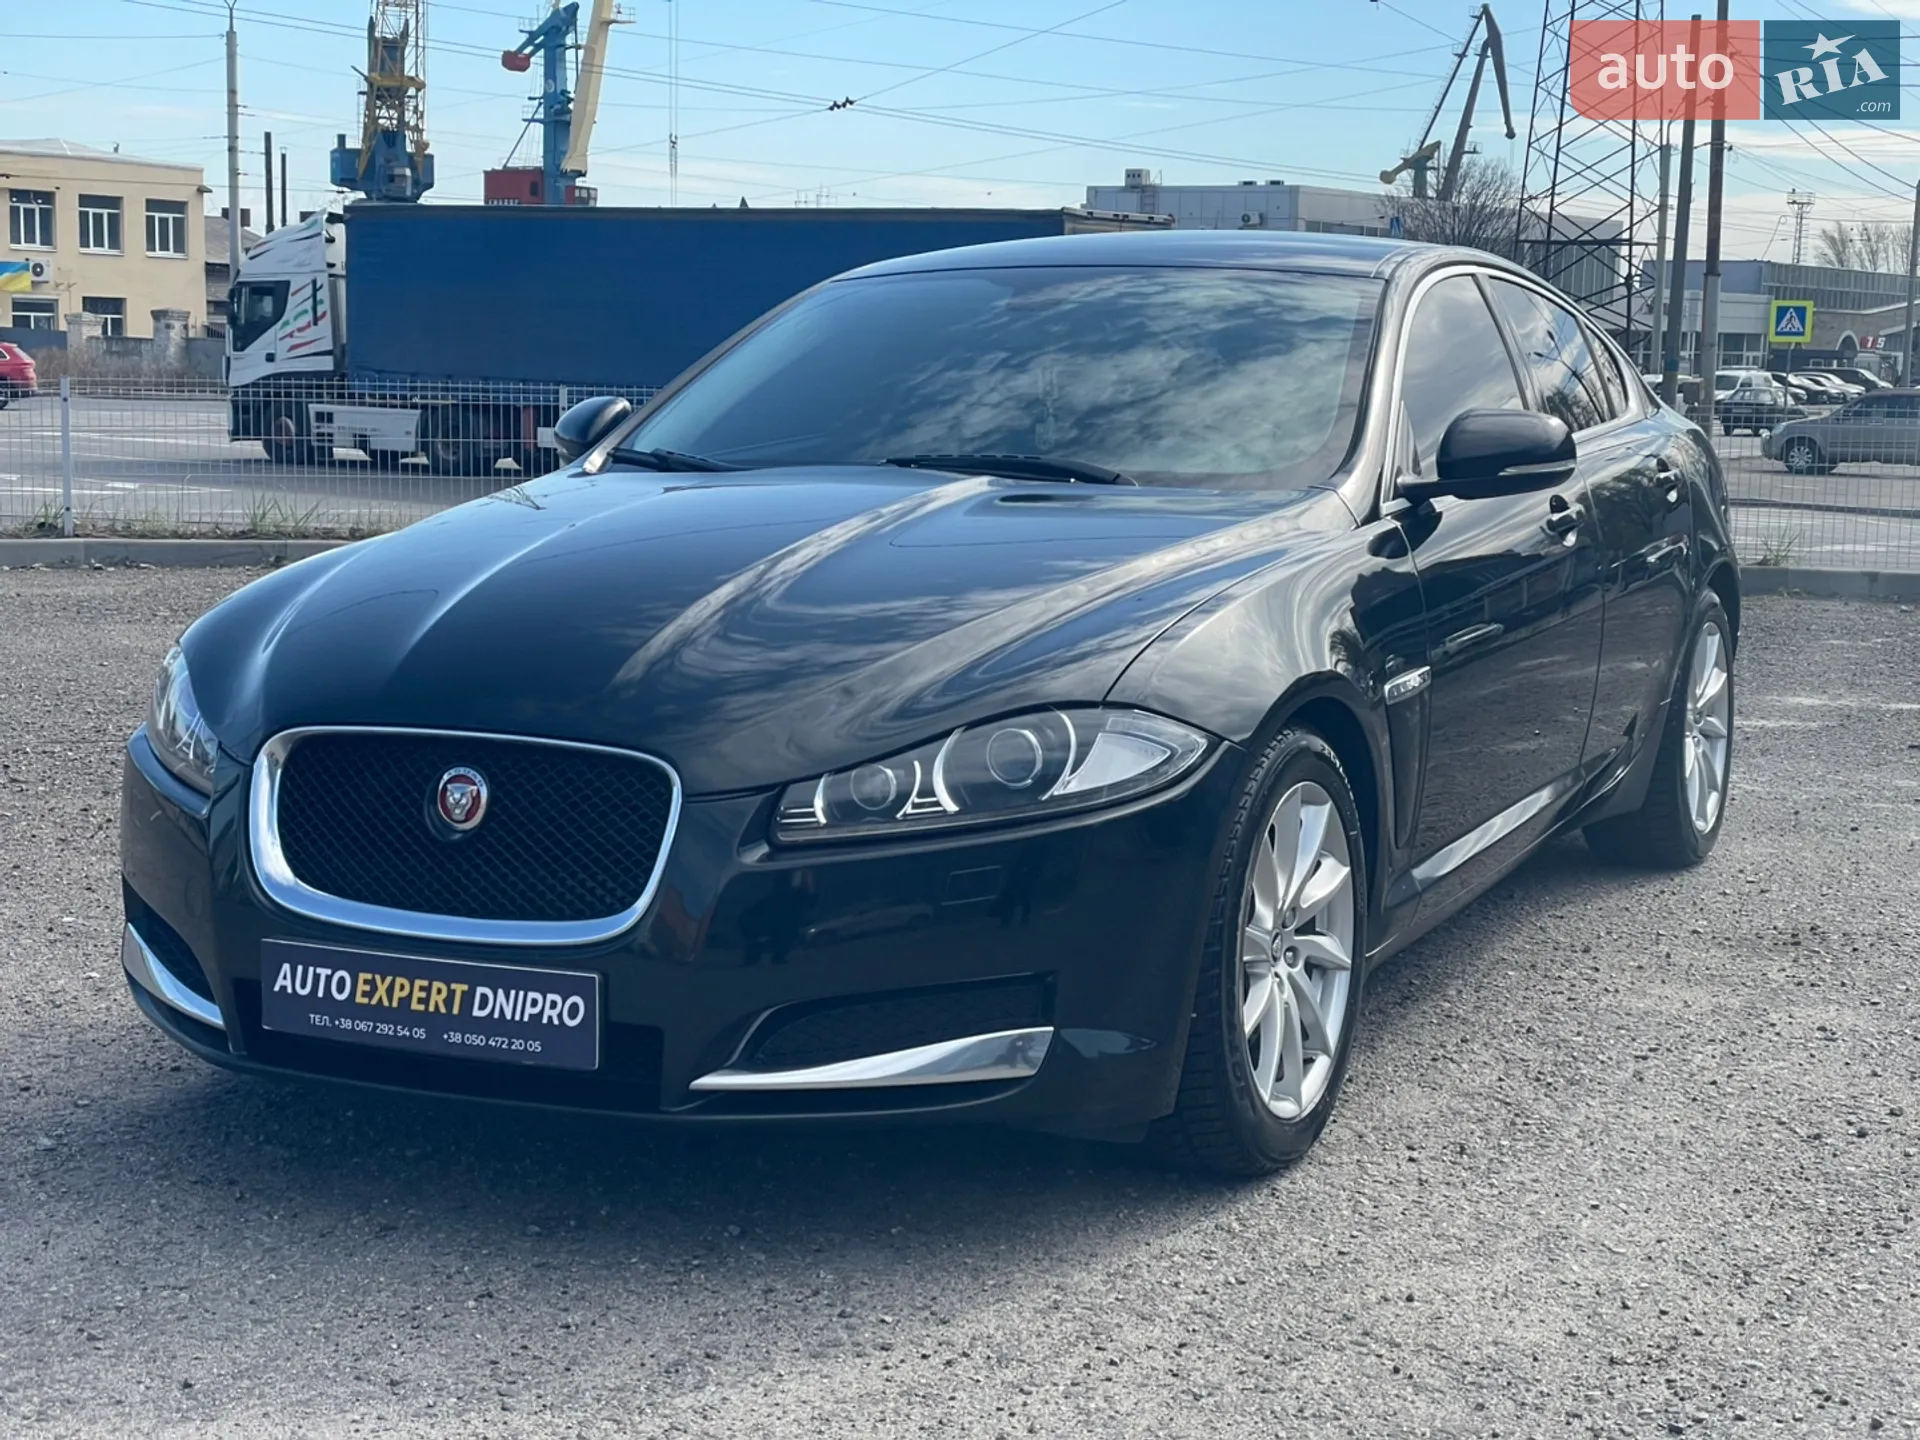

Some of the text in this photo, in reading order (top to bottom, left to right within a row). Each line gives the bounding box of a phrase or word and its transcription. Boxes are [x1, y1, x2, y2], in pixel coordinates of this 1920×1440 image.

[273, 962, 585, 1027] AUTO EXPERT DNIPRO
[308, 1013, 426, 1040] ТЕЛ. +38 067 292 54 05
[443, 1031, 542, 1053] +38 050 472 20 05
